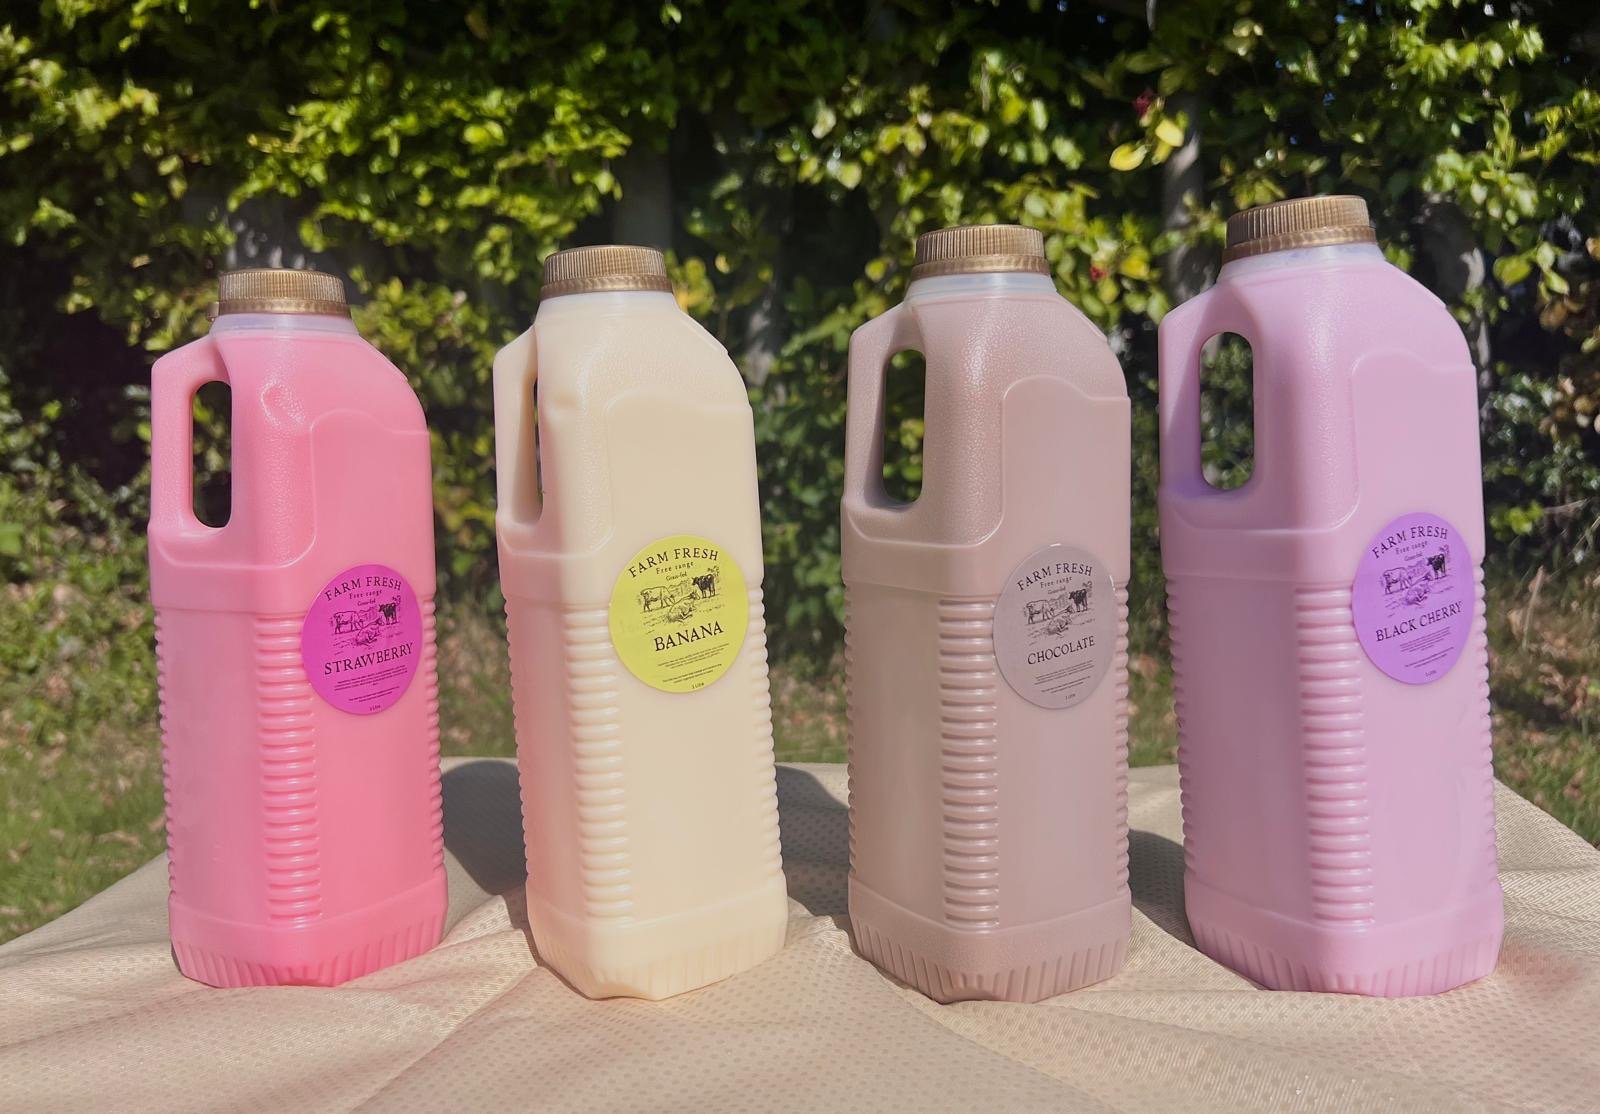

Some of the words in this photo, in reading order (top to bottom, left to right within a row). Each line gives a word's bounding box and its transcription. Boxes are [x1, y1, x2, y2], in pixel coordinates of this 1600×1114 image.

[1372, 531, 1407, 559] FARM
[1411, 525, 1448, 540] FRESH
[628, 551, 669, 578] FARM
[674, 547, 719, 561] FRESH
[656, 566, 672, 575] Free
[675, 561, 694, 570] range
[1016, 565, 1052, 591] FARM
[1056, 562, 1093, 576] FRESH
[325, 578, 362, 601] FARM
[366, 576, 402, 591] FRESH
[349, 592, 364, 600] Free
[366, 589, 383, 597] range
[1040, 580, 1054, 588] Free
[1056, 576, 1073, 585] range
[654, 620, 724, 652] BANANA
[1375, 618, 1417, 642] BLACK
[1419, 600, 1463, 627] CHERRY
[324, 642, 413, 675] STRAWBERRY
[1027, 635, 1095, 665] CHOCOLATE
